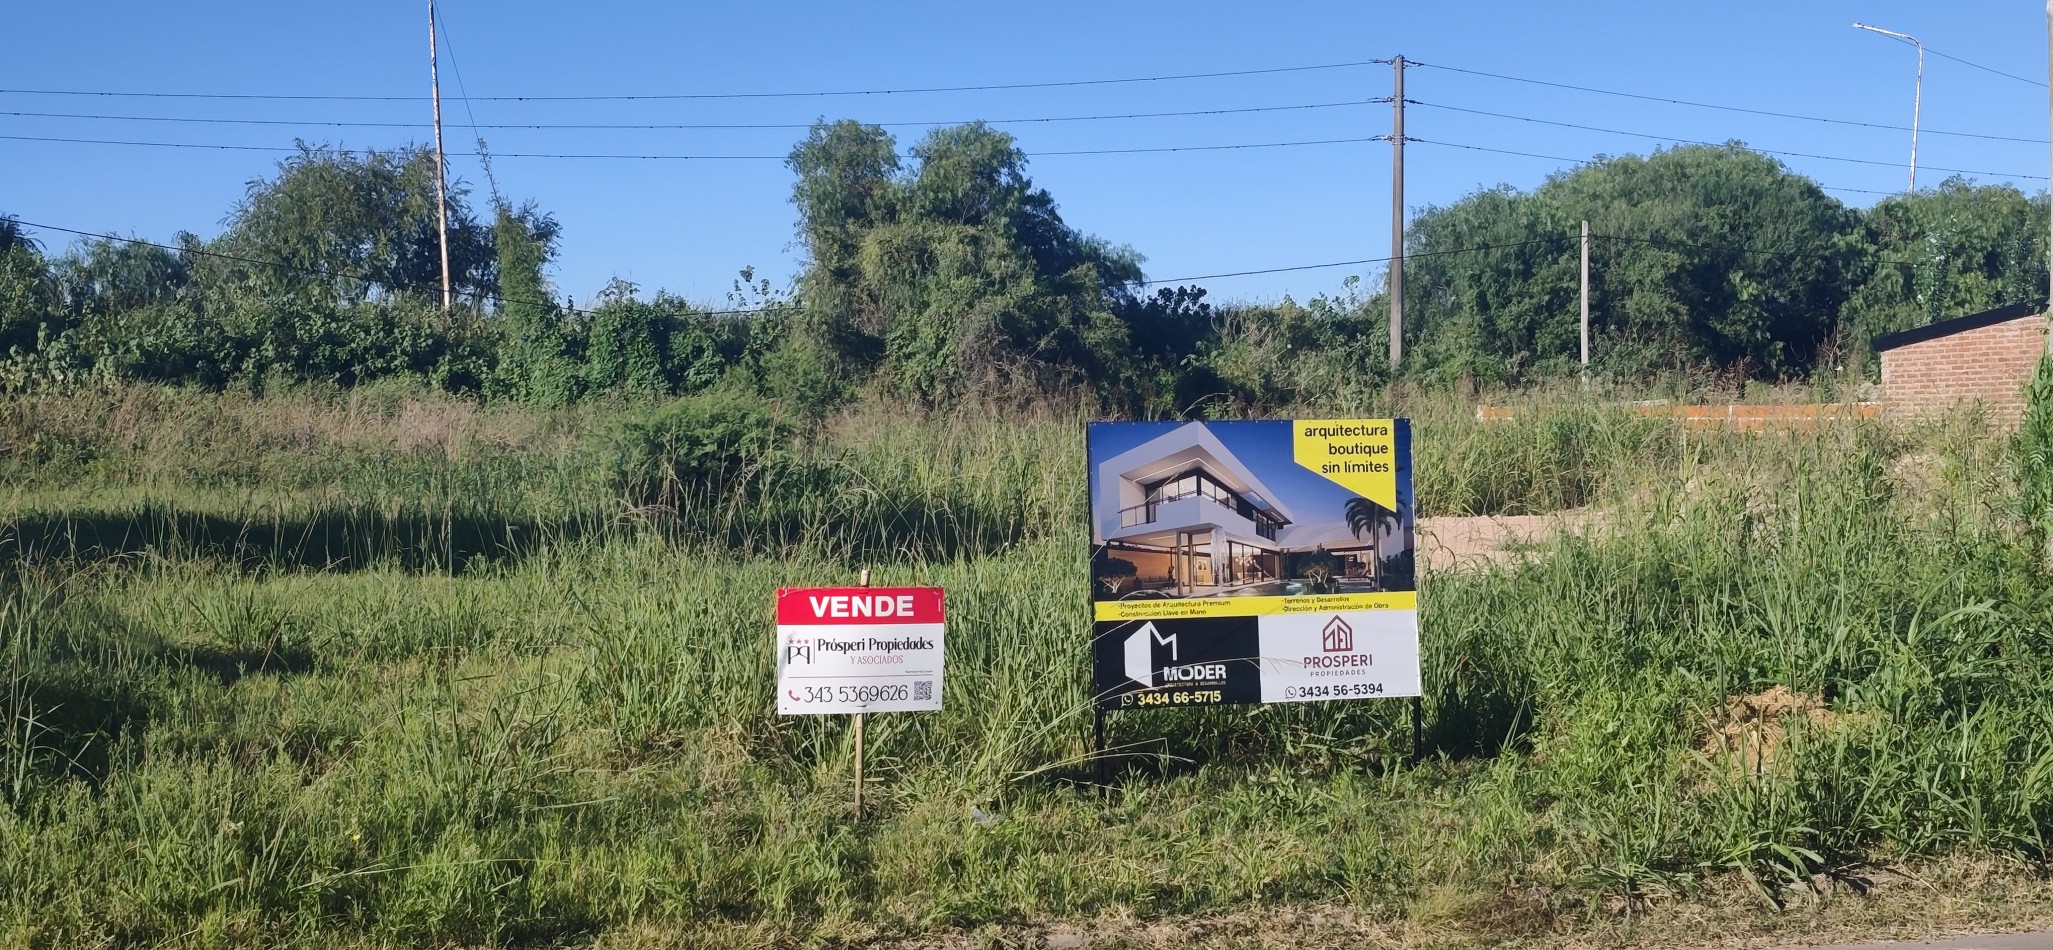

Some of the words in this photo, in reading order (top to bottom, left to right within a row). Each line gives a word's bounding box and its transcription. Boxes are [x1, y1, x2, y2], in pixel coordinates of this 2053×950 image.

[1304, 424, 1388, 440] arquitectura
[1328, 442, 1389, 457] boutique
[1321, 461, 1340, 474] sin
[1344, 460, 1389, 473] límites
[809, 595, 915, 618] VENDE
[817, 638, 865, 655] Prósperi
[868, 637, 934, 654] Propiedades
[850, 655, 857, 665] Y
[857, 655, 904, 665] ASOCIADOS
[1303, 653, 1373, 669] PROSPERI
[1163, 664, 1227, 681] MODER
[1310, 668, 1366, 677] PROPIEDADES
[803, 686, 833, 703] 343
[838, 685, 908, 702] 5369626
[1137, 692, 1170, 706] 3434
[1172, 690, 1222, 704] 66-5715
[1298, 685, 1330, 698] 3434
[1333, 682, 1384, 696] 56-5394
